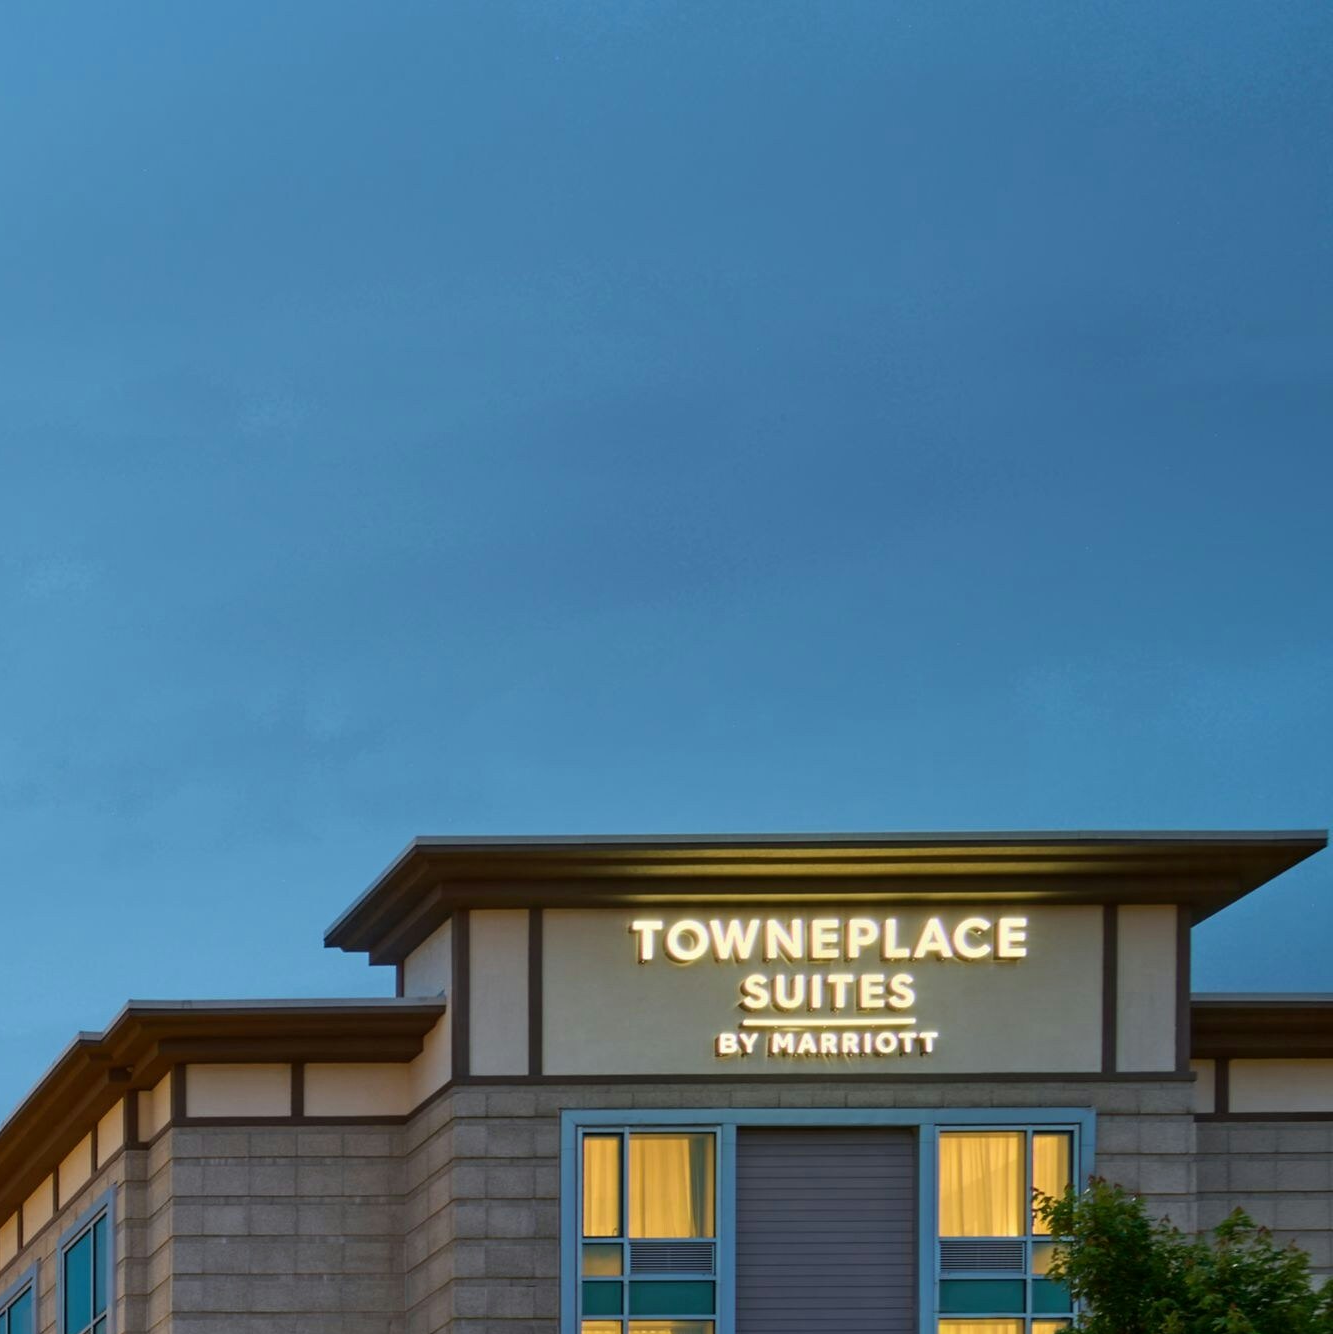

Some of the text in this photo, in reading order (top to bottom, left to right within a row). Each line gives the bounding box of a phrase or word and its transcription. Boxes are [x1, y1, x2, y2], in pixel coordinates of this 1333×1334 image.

[632, 917, 1028, 961] TOWNEPLACE
[741, 973, 916, 1010] SUITES
[716, 1031, 939, 1055] BY MARRIOTT
